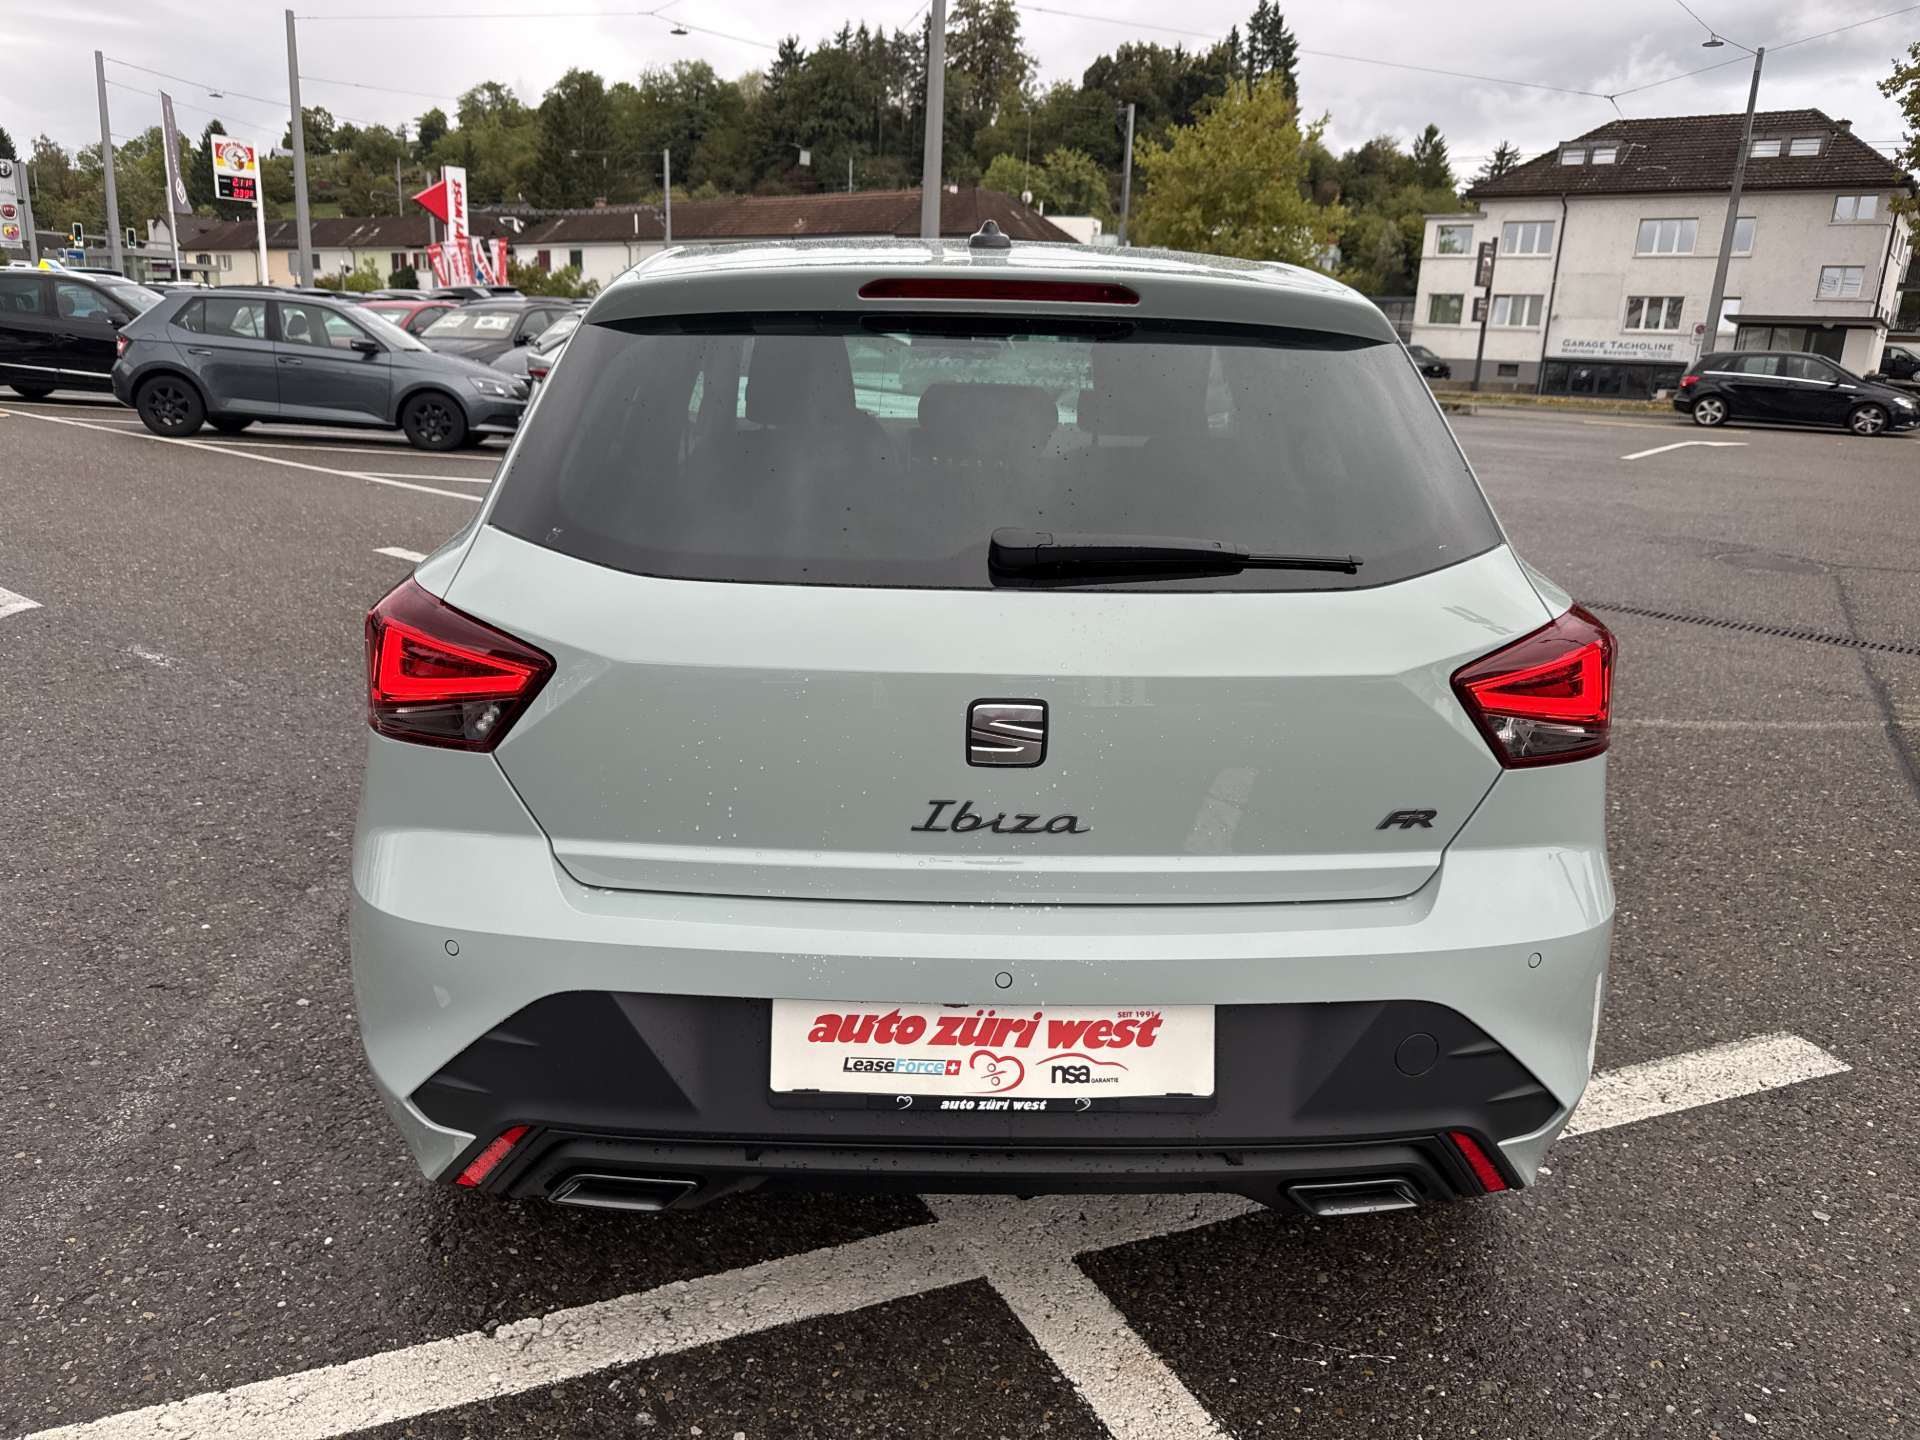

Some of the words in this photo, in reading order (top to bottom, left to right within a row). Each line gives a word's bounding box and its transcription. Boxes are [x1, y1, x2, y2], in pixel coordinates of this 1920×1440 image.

[1562, 339, 1606, 349] GARAGE
[1609, 340, 1674, 351] TACHOLINE
[911, 799, 1090, 834] Ibiza
[1376, 809, 1437, 829] FR
[808, 1008, 927, 1045] auto
[927, 1010, 1043, 1048] züri
[1048, 1012, 1163, 1049] west
[843, 1057, 945, 1073] LeaseForce
[1051, 1065, 1090, 1084] nsa
[940, 1099, 975, 1110] auto
[977, 1099, 1010, 1110] züri
[1013, 1100, 1047, 1110] west
